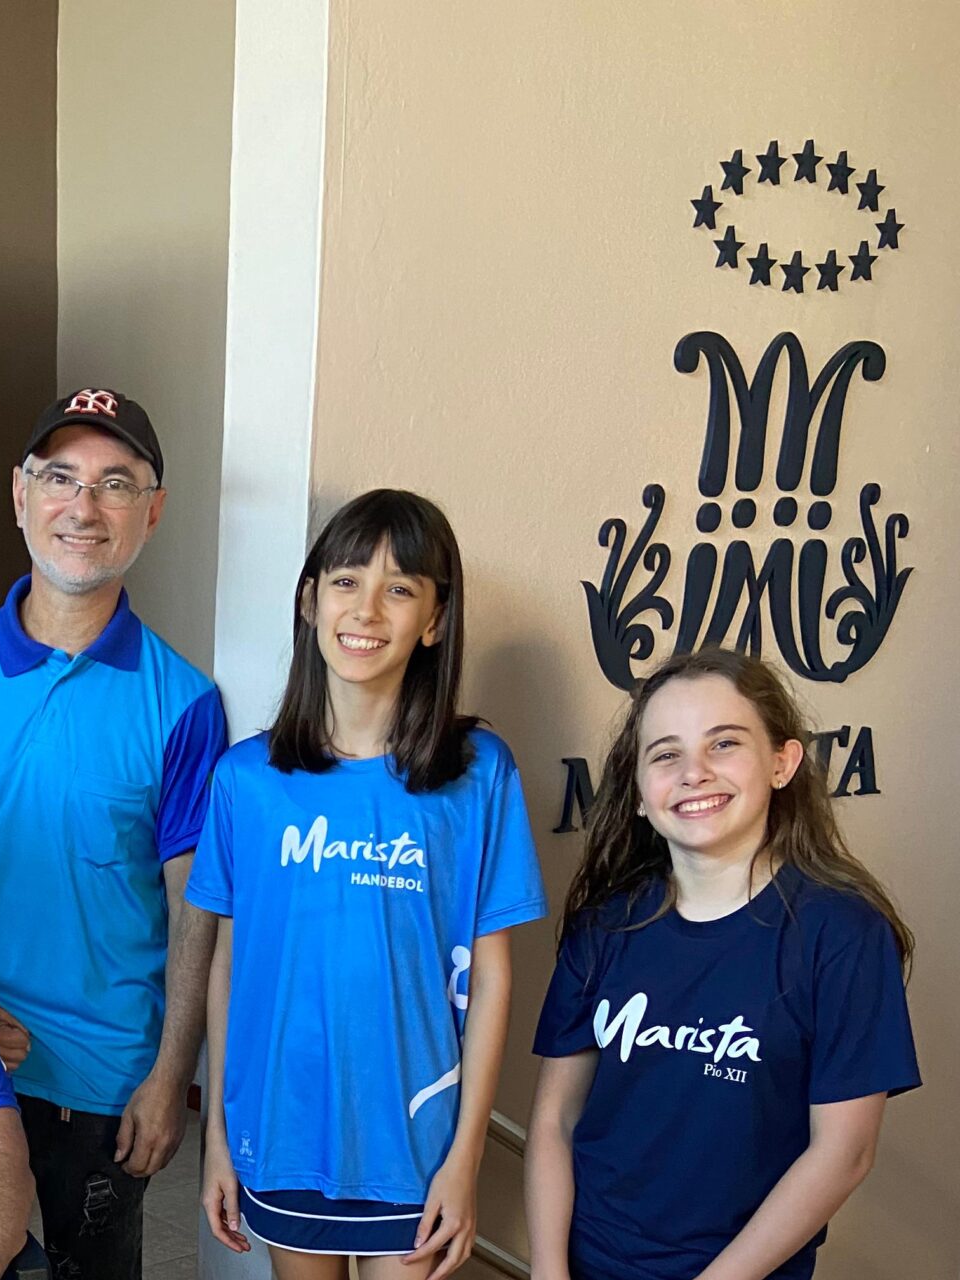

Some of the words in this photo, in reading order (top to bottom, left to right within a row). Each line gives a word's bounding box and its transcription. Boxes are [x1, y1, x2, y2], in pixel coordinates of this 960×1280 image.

[280, 815, 426, 873] Marista
[351, 872, 424, 892] HANDEBOL
[703, 1063, 722, 1078] Pio
[723, 1066, 748, 1084] XII
